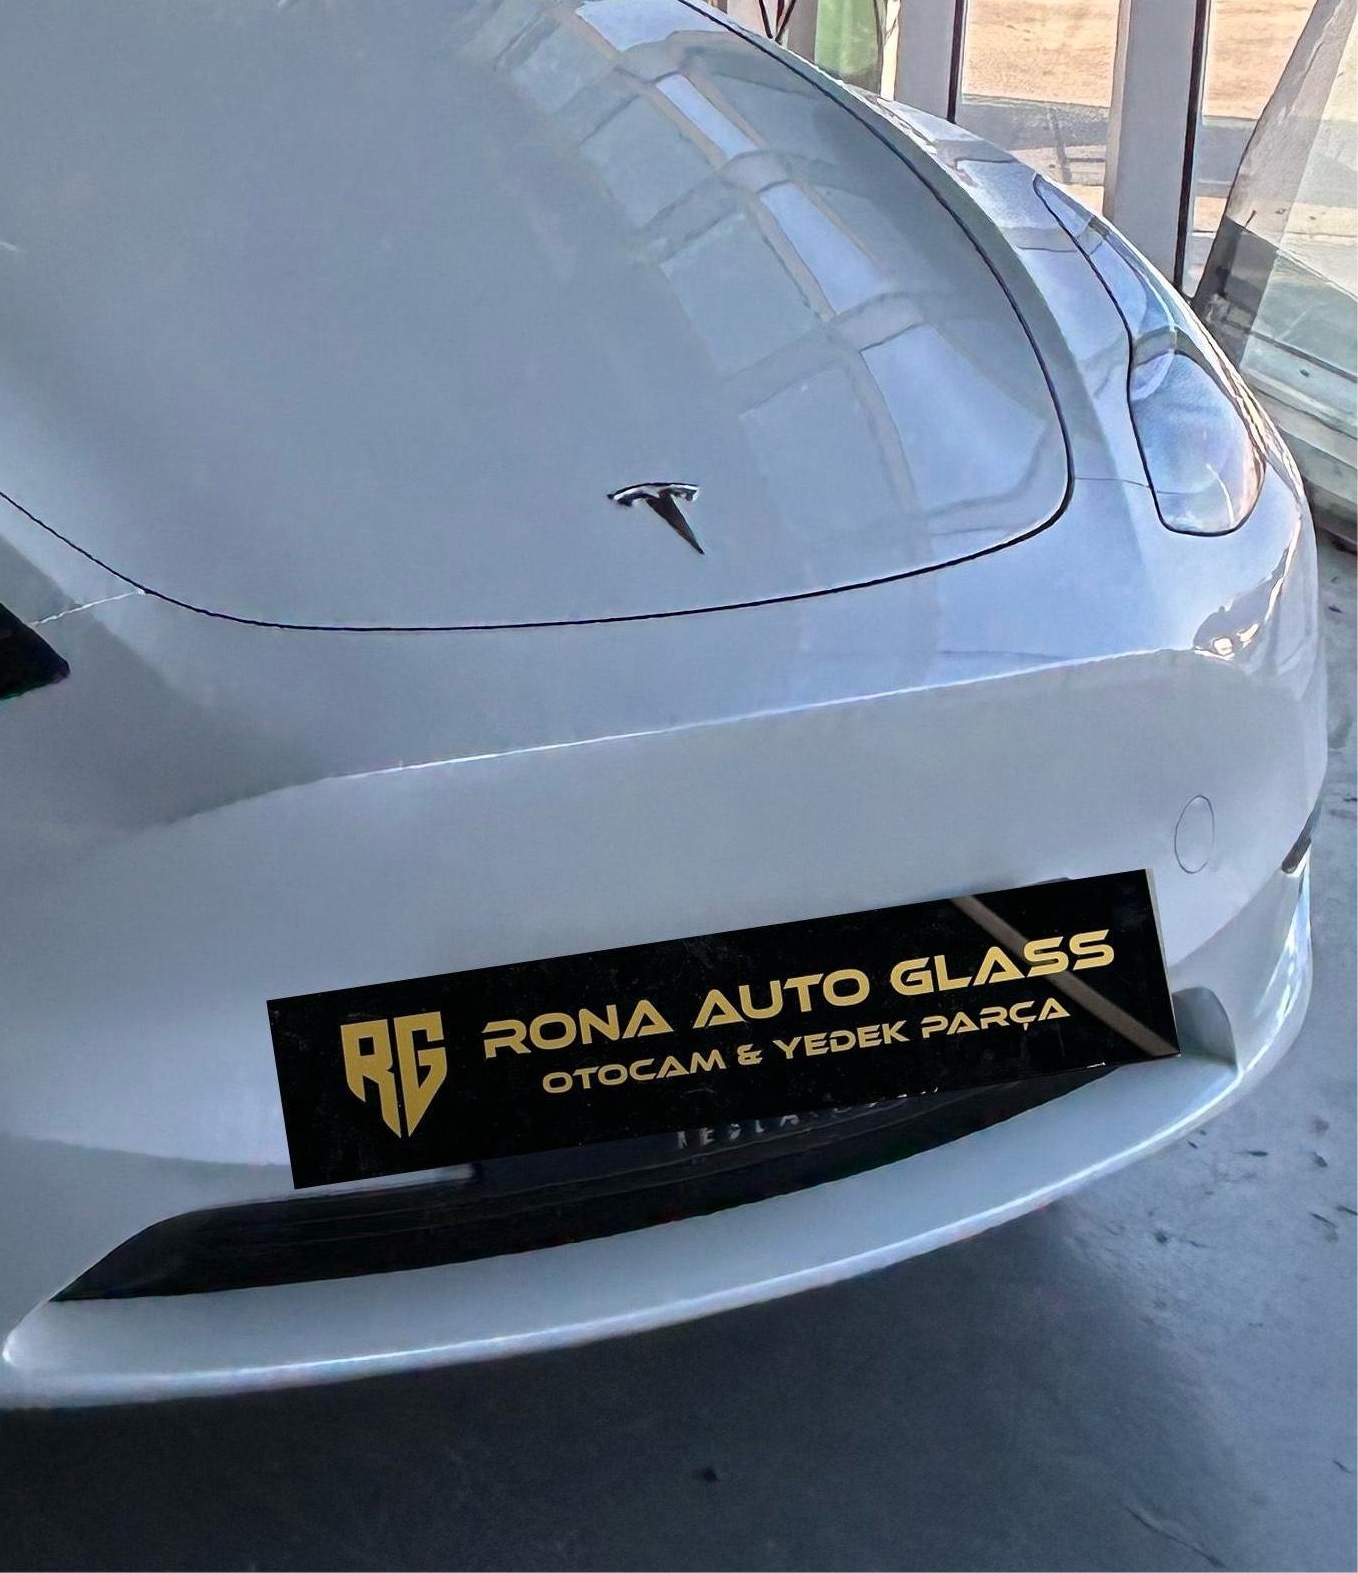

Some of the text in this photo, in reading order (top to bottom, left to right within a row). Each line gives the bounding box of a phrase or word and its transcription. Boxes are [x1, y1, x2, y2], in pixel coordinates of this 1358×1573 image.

[482, 929, 1115, 1059] RONA AUTO GLASS
[542, 997, 1071, 1094] OTOCAM & YEDEK PARÇA
[340, 1010, 448, 1138] RG
